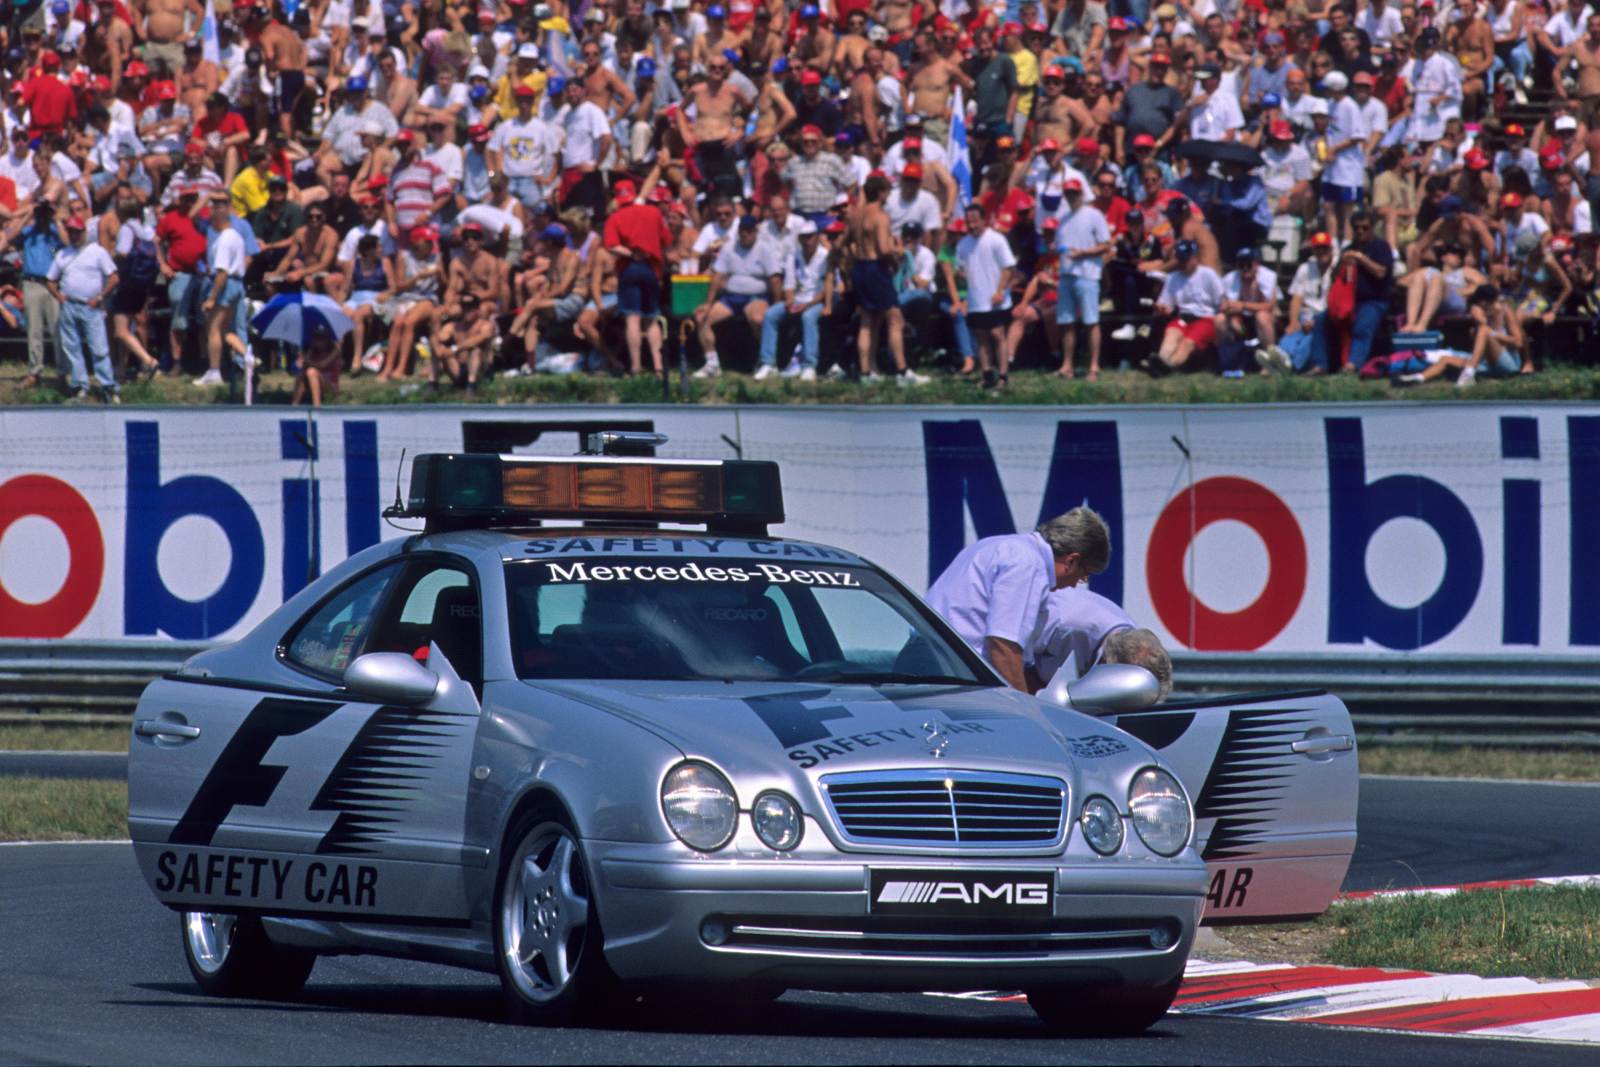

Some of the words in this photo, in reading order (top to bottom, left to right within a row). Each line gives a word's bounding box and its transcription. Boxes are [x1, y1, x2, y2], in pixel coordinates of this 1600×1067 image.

[0, 419, 381, 641] obil
[524, 537, 729, 555] SAFETY
[748, 541, 850, 561] CAR
[922, 416, 1600, 652] Mobil
[546, 562, 861, 587] Mercedes-Benz
[704, 608, 768, 621] RECARO
[788, 728, 915, 769] SAFETY
[921, 720, 995, 738] CAR
[155, 850, 293, 899] SAFETY
[304, 861, 378, 906] CAR
[929, 881, 1048, 904] AMG
[1206, 868, 1254, 909] AR
